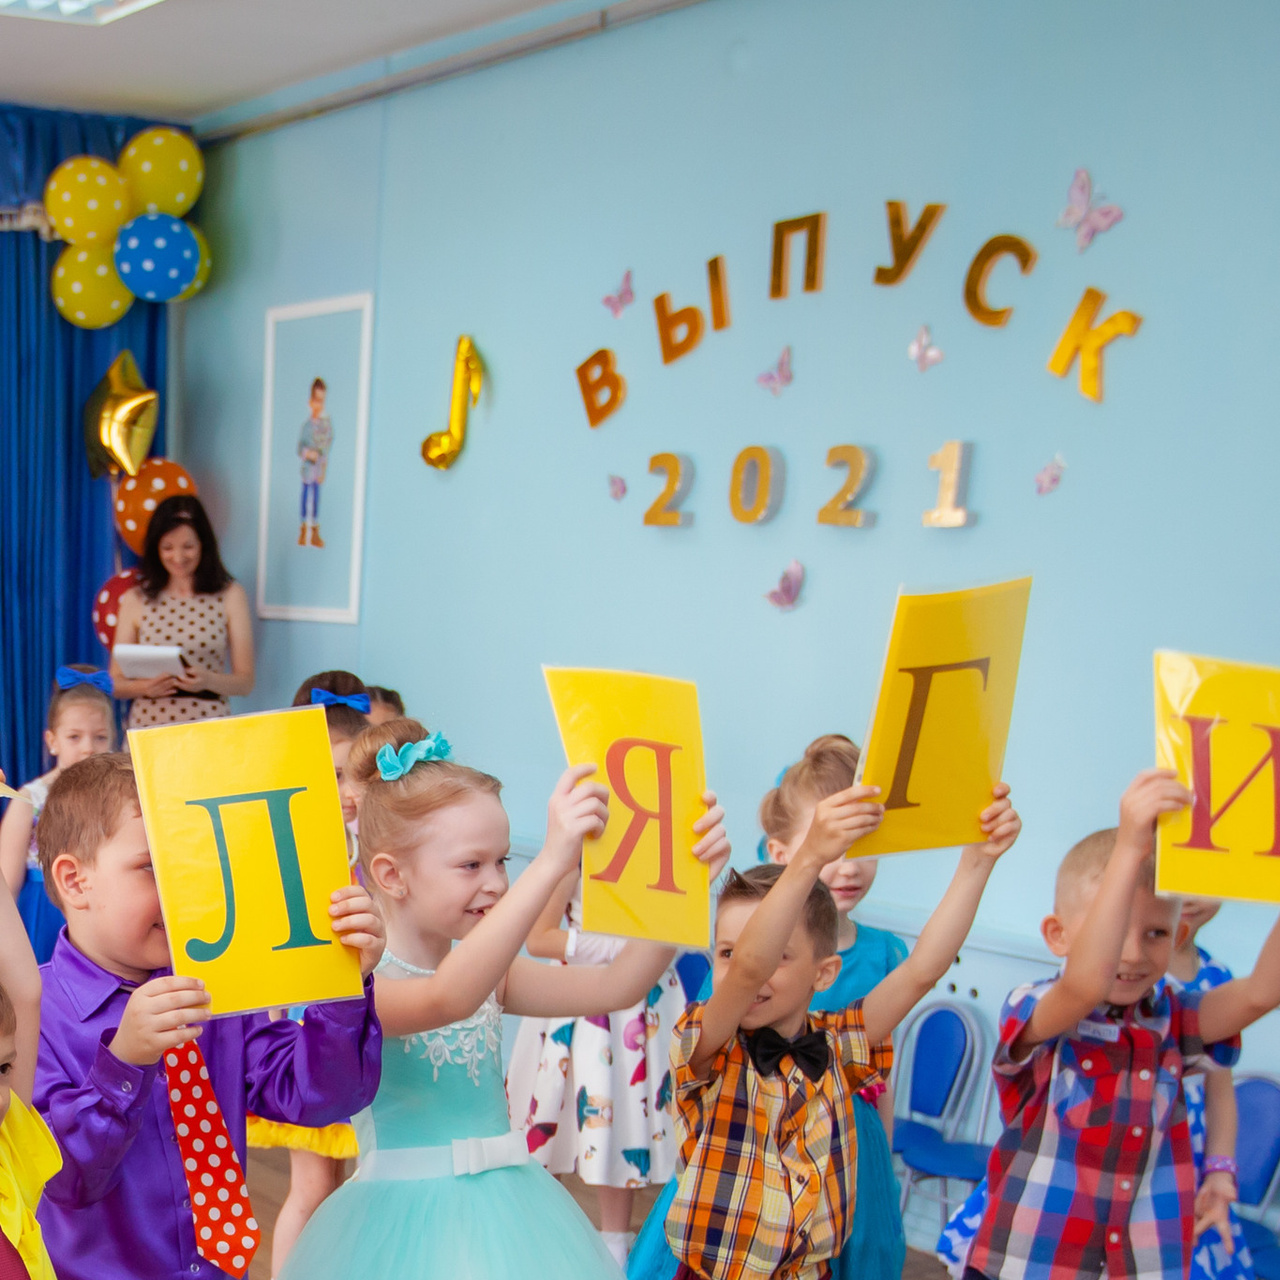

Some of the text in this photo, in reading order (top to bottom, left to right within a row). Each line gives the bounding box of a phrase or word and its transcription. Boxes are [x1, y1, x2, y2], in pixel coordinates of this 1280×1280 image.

[575, 200, 1144, 429] ВЫПУСК
[643, 440, 969, 528] 2021
[883, 656, 991, 811] Г
[1171, 714, 1280, 858] И
[184, 786, 333, 963] Л
[588, 737, 688, 895] Я
